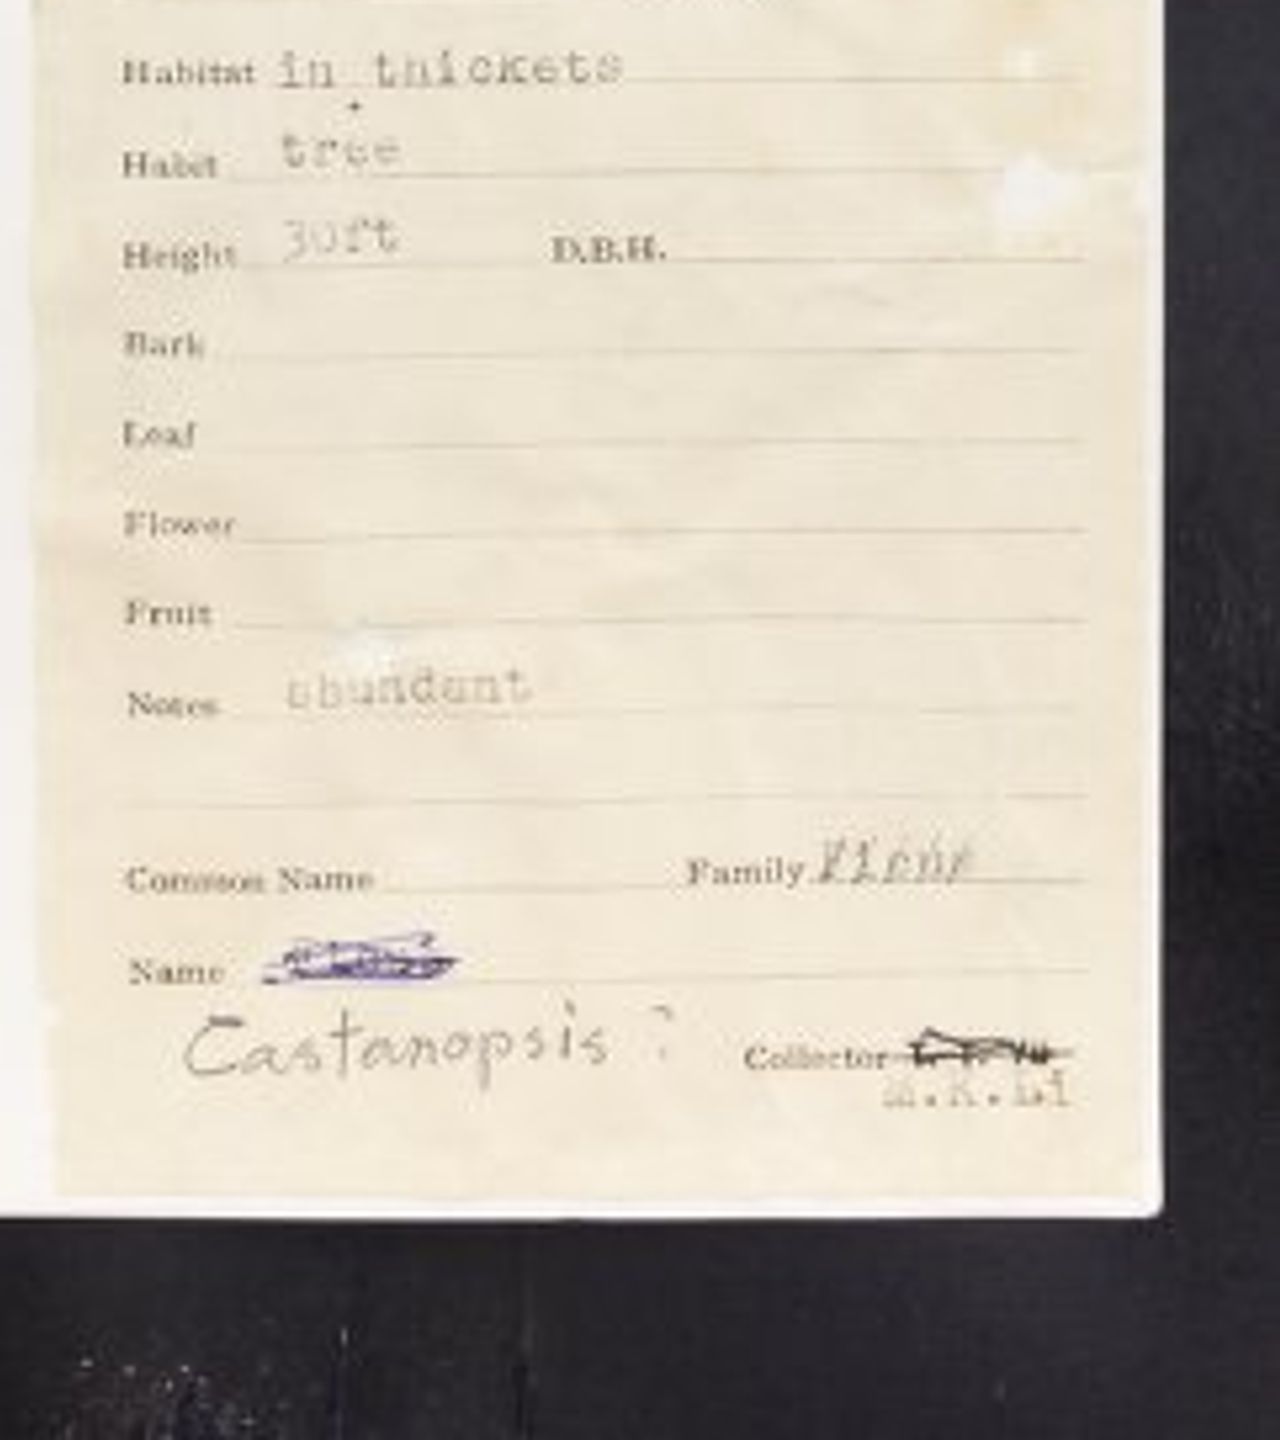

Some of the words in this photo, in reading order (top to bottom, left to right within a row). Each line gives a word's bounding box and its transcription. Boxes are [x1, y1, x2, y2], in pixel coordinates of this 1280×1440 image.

[122, 58, 256, 87] Habitat
[277, 53, 336, 89] in
[122, 151, 220, 180] Habit
[281, 134, 402, 170] tree
[122, 242, 239, 274] Height
[551, 236, 667, 266] D.B.H.
[123, 330, 206, 361] Bark
[122, 420, 197, 450] Leaf
[123, 509, 236, 541] Flower
[124, 599, 214, 629] Fruit
[128, 690, 220, 721] Notes
[126, 866, 266, 895] Common
[278, 864, 375, 893] Name
[686, 857, 805, 889] Family
[129, 960, 225, 986] Name
[182, 1001, 608, 1090] Castanopsis
[743, 1044, 887, 1073] Collector
